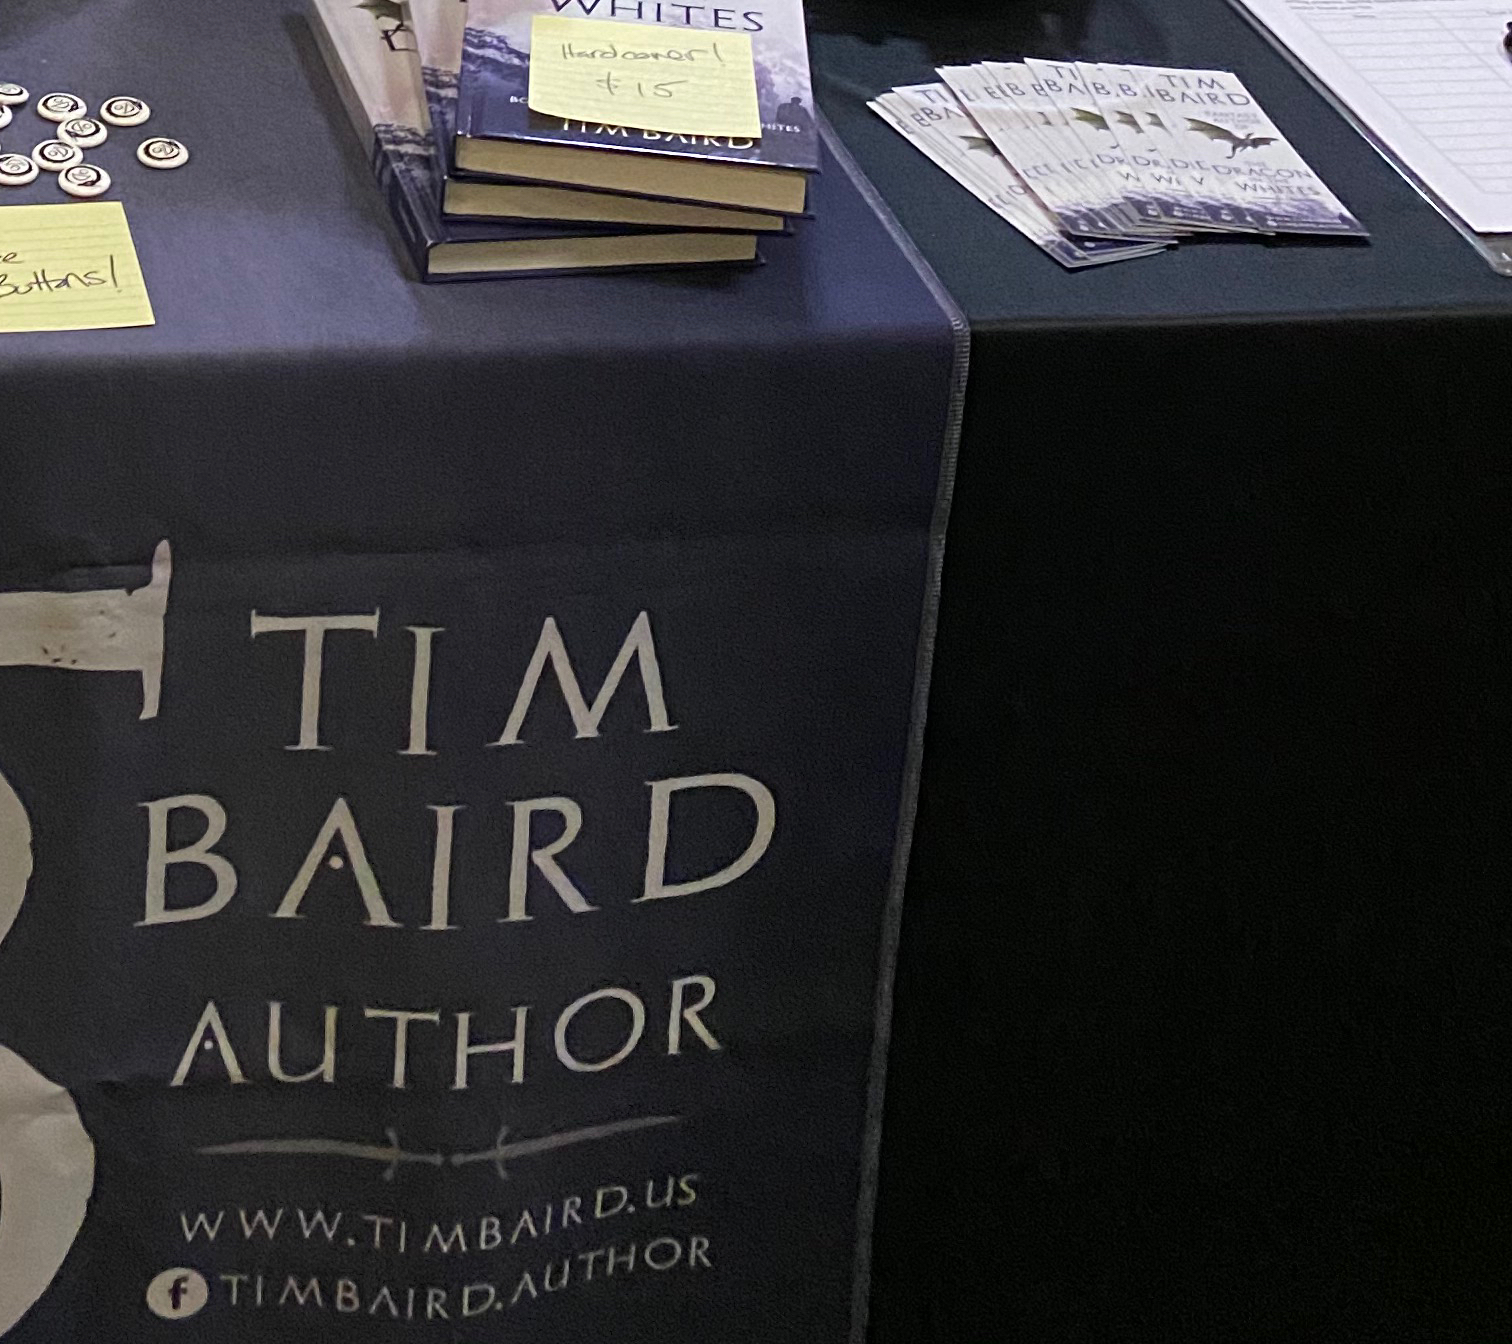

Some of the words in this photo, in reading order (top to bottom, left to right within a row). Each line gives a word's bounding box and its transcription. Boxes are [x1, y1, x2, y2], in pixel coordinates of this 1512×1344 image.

[1155, 88, 1251, 106] BAIRD
[1158, 73, 1225, 91] TIM
[250, 606, 680, 757] TIM
[133, 772, 777, 932] BAIRD
[169, 974, 723, 1090] AUTHOR
[180, 1175, 699, 1254] WWW.TIMBAIRD.US
[220, 1236, 713, 1320] TIMBAIRD.AUTHOR
